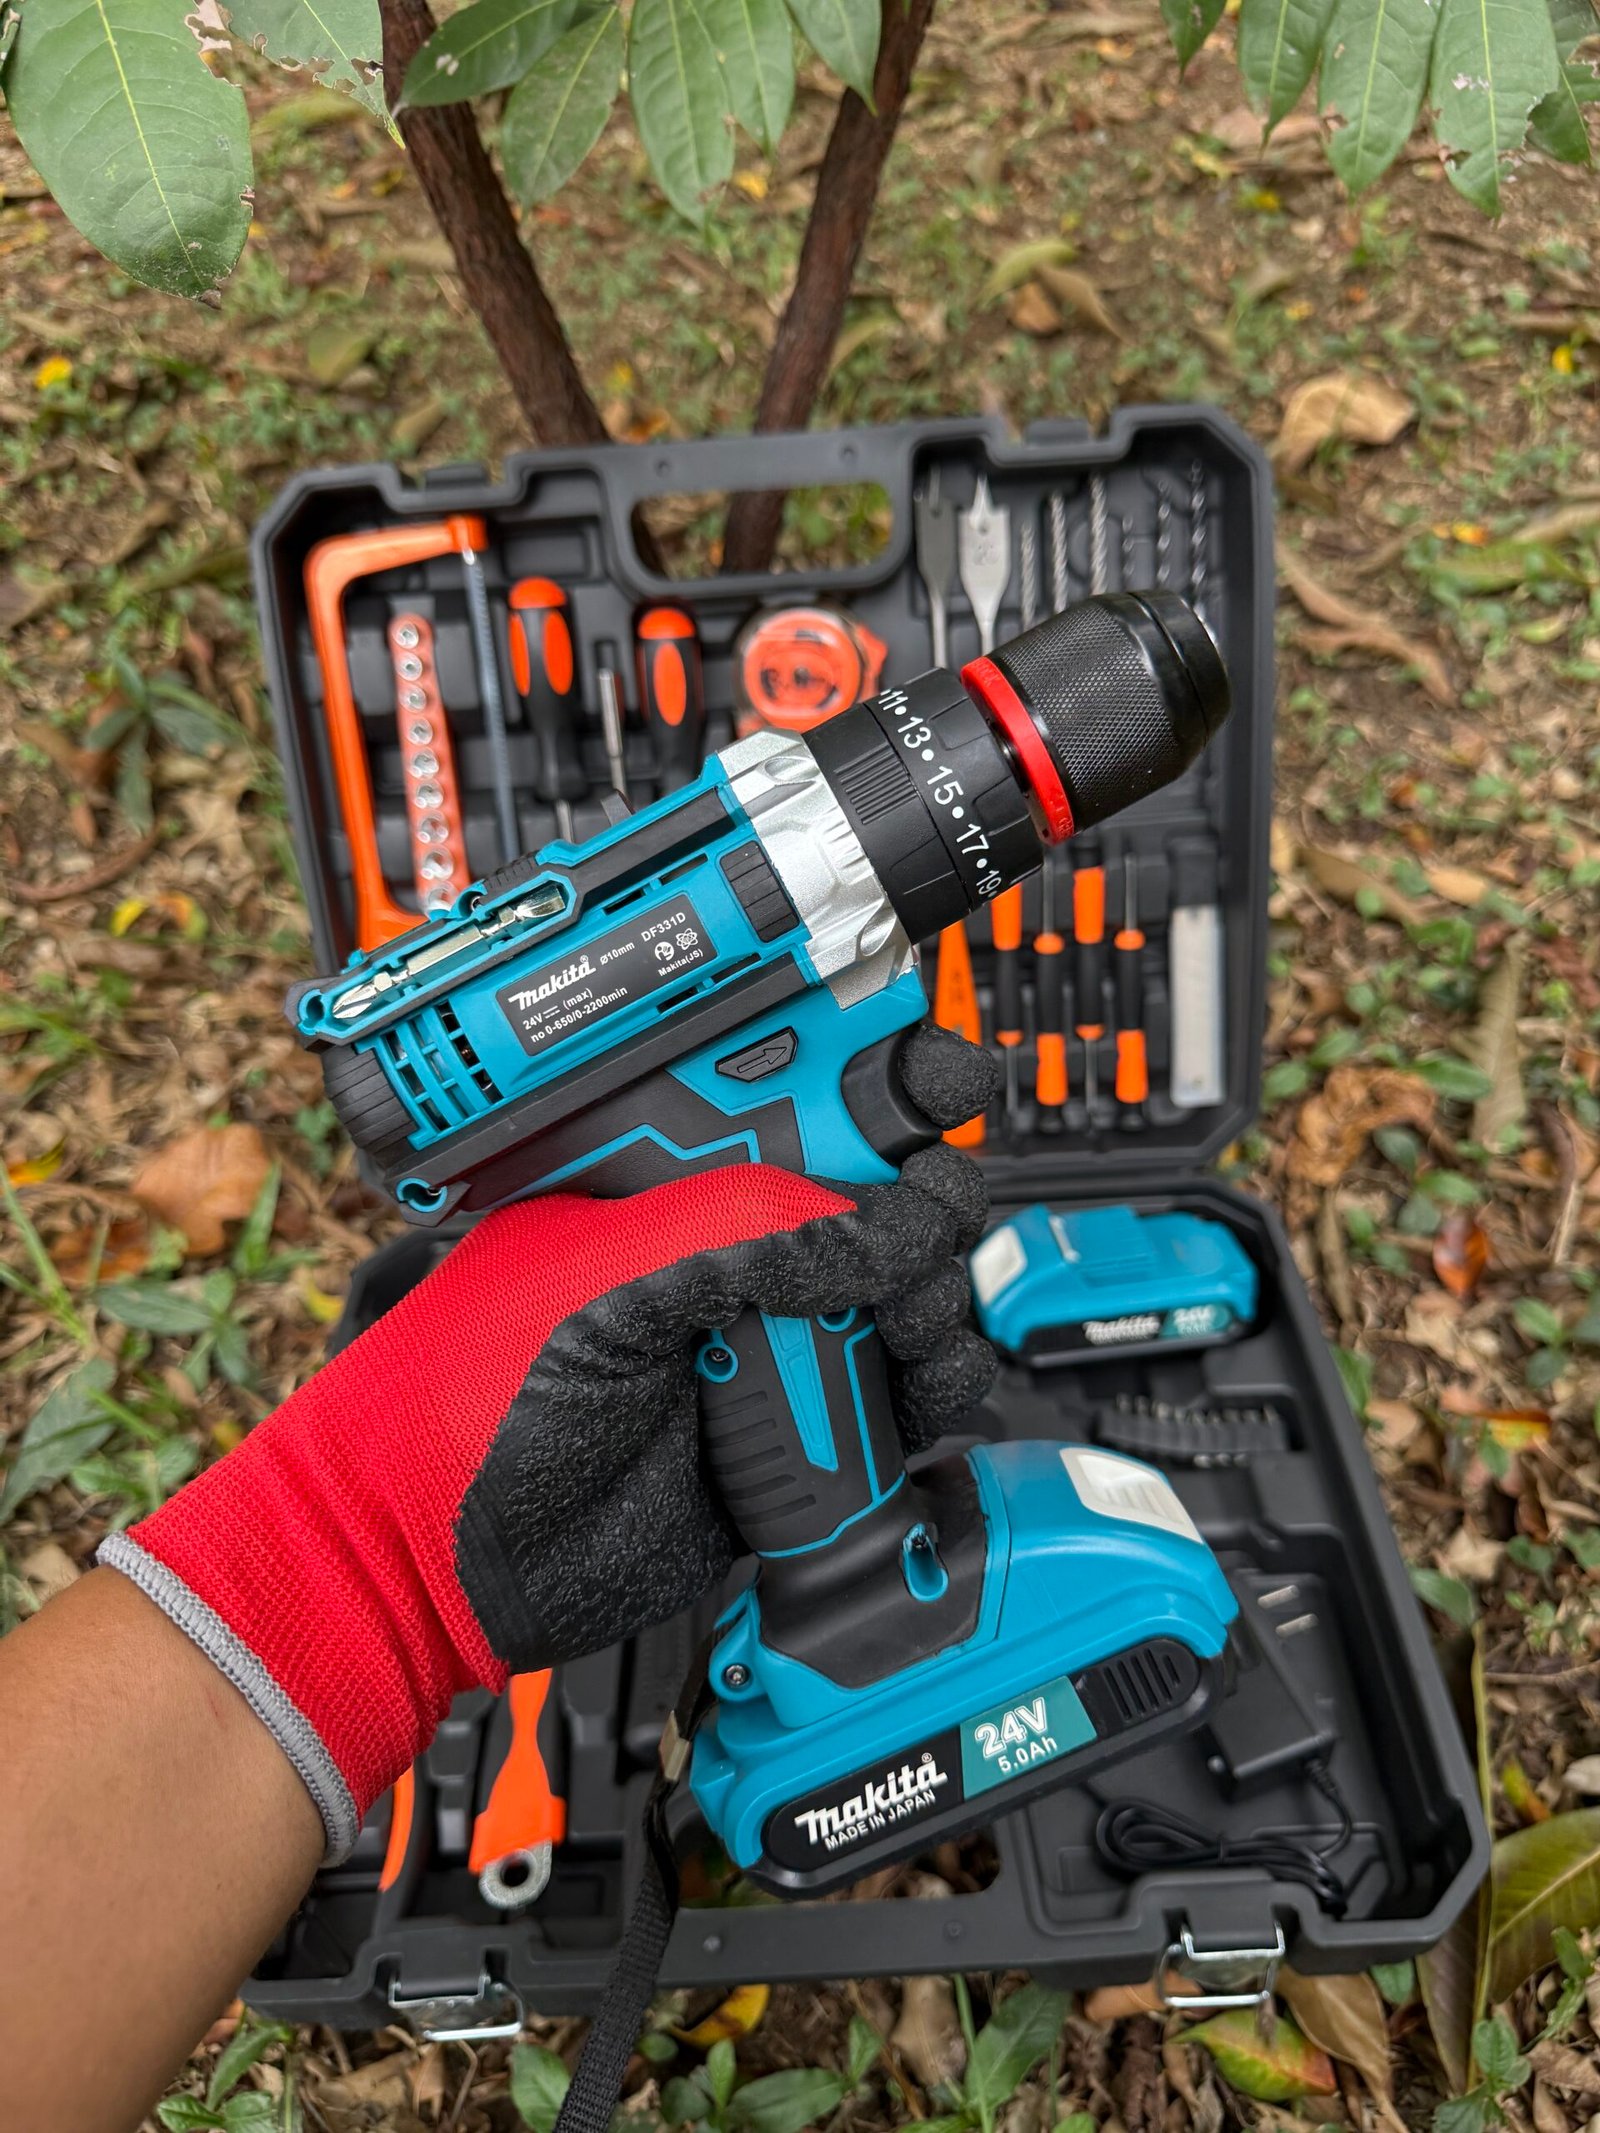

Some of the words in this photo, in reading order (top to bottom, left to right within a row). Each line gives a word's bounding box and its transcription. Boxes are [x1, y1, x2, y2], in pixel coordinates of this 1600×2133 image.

[878, 690, 909, 711] 11
[898, 716, 932, 749] 13
[927, 765, 964, 806] 15
[956, 823, 989, 854] 17
[976, 869, 1002, 895] 19
[640, 911, 687, 943] DF331D
[657, 948, 704, 977] Makita(JS)
[522, 1011, 544, 1031] 24V
[562, 988, 594, 1011] (max)
[530, 1029, 546, 1043] no
[546, 986, 628, 1036] 0-650/0-2200min
[974, 1696, 1048, 1760] 24V
[997, 1736, 1058, 1774] 5.0Ah
[824, 1820, 869, 1852] MADE
[869, 1812, 887, 1832] IN
[888, 1788, 937, 1822] JAPAN
